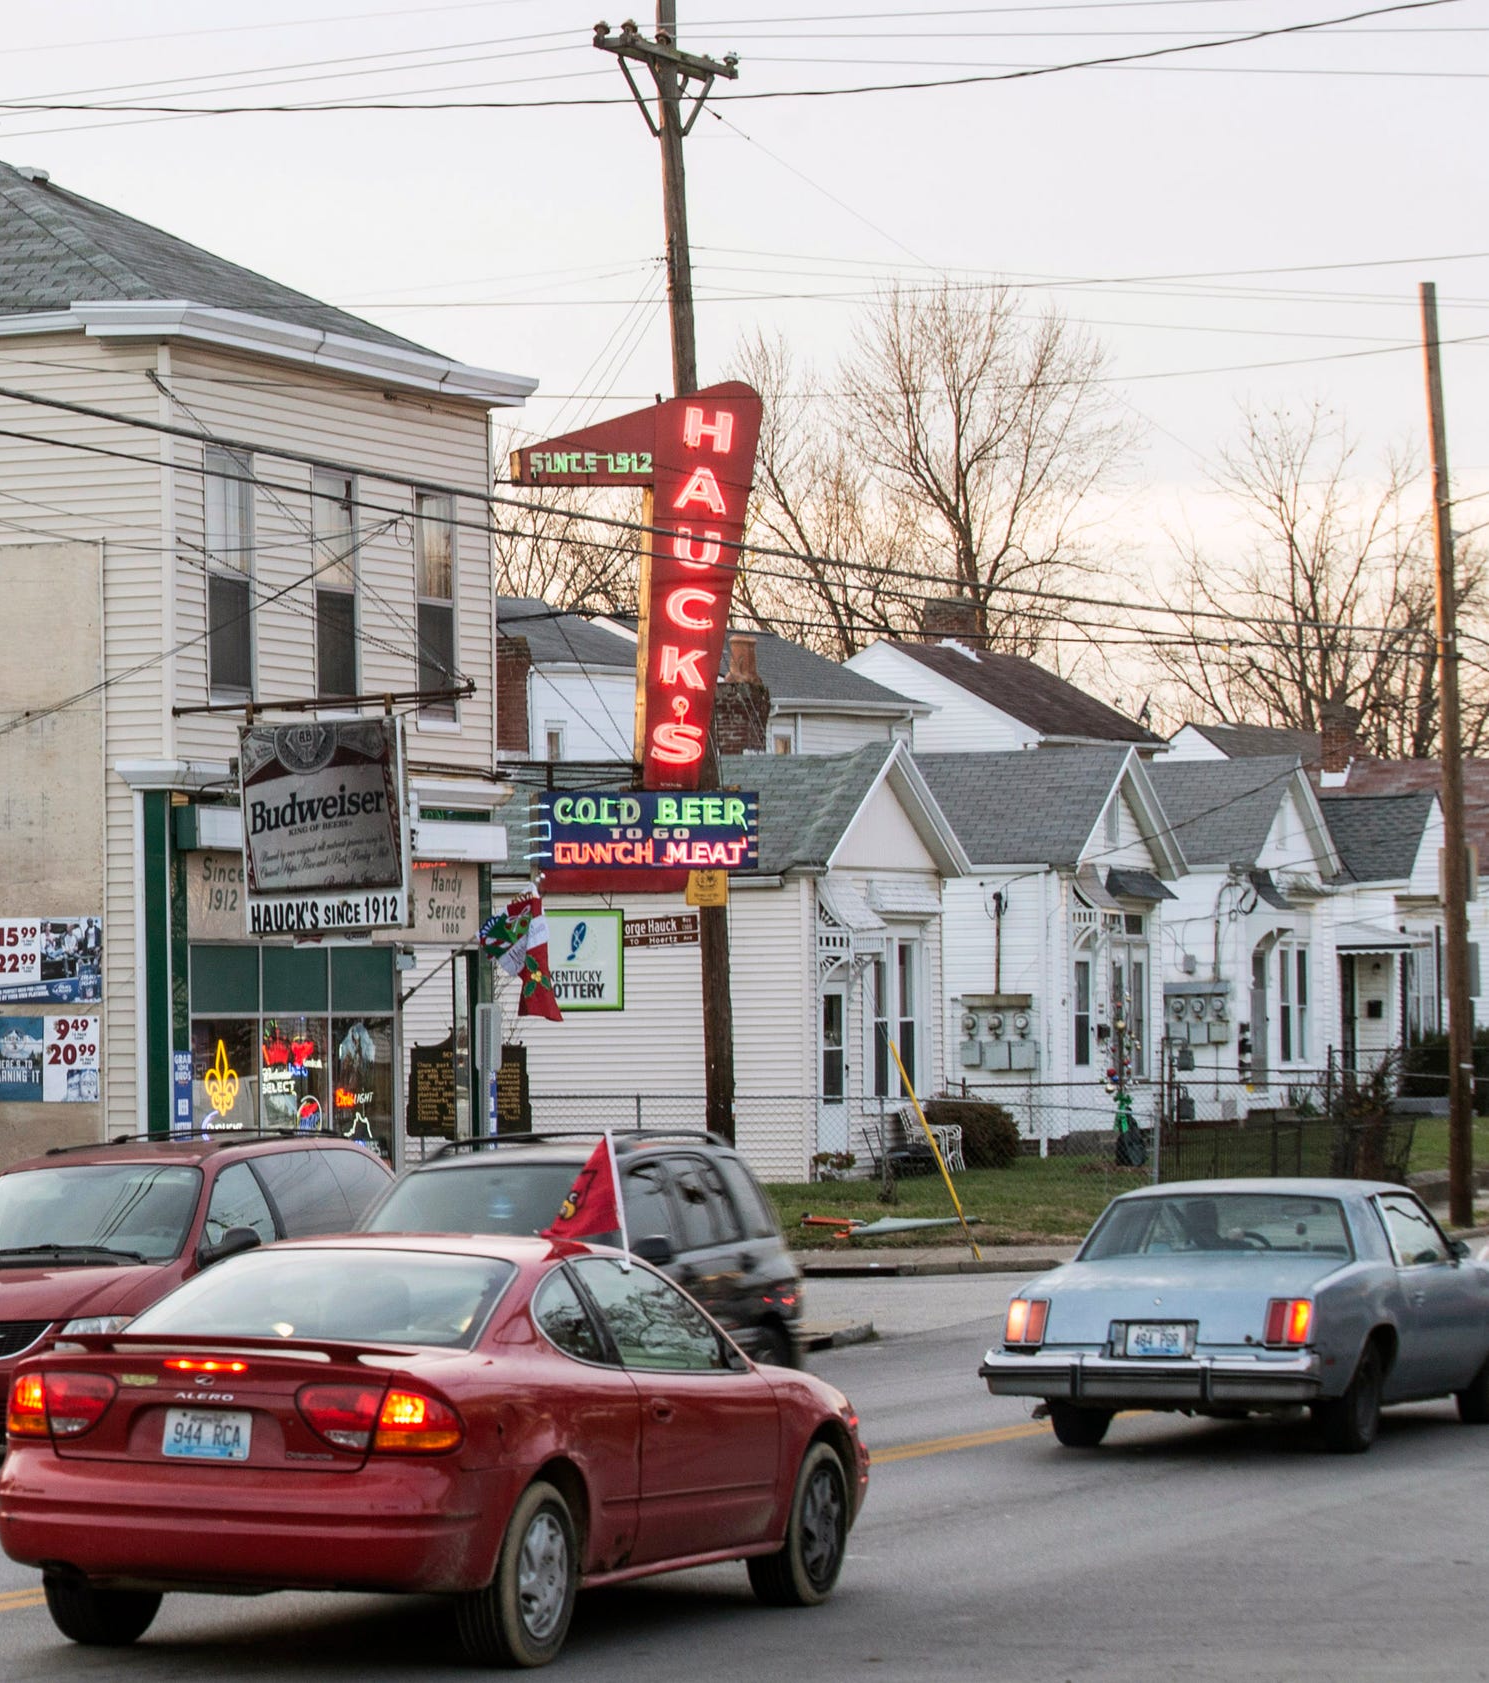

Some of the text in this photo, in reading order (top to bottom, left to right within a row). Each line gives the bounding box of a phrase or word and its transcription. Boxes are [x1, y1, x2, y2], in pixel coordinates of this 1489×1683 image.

[530, 452, 653, 473] SINCE 1912
[251, 784, 384, 836] Budweiser
[553, 797, 747, 829] COLD BEER
[288, 826, 308, 837] KING
[309, 824, 321, 833] OF
[609, 828, 690, 839] TO GO
[554, 838, 747, 864] LUNCH MEAT
[202, 857, 244, 883] Since
[432, 869, 462, 899] Handy
[209, 887, 238, 911] 1912
[427, 897, 466, 919] Service
[251, 896, 398, 933] HAUCK'S SINCE 1912
[442, 922, 460, 934] 1000
[625, 922, 646, 936] orge
[648, 918, 677, 933] Hauck
[649, 935, 677, 944] Hoertz
[553, 983, 605, 998] OTTERY
[25, 1060, 33, 1069] TO
[174, 1054, 191, 1065] GRAB
[32, 1070, 40, 1083] IT
[174, 1392, 234, 1401] ALERO
[174, 1422, 241, 1447] 944 RCA
